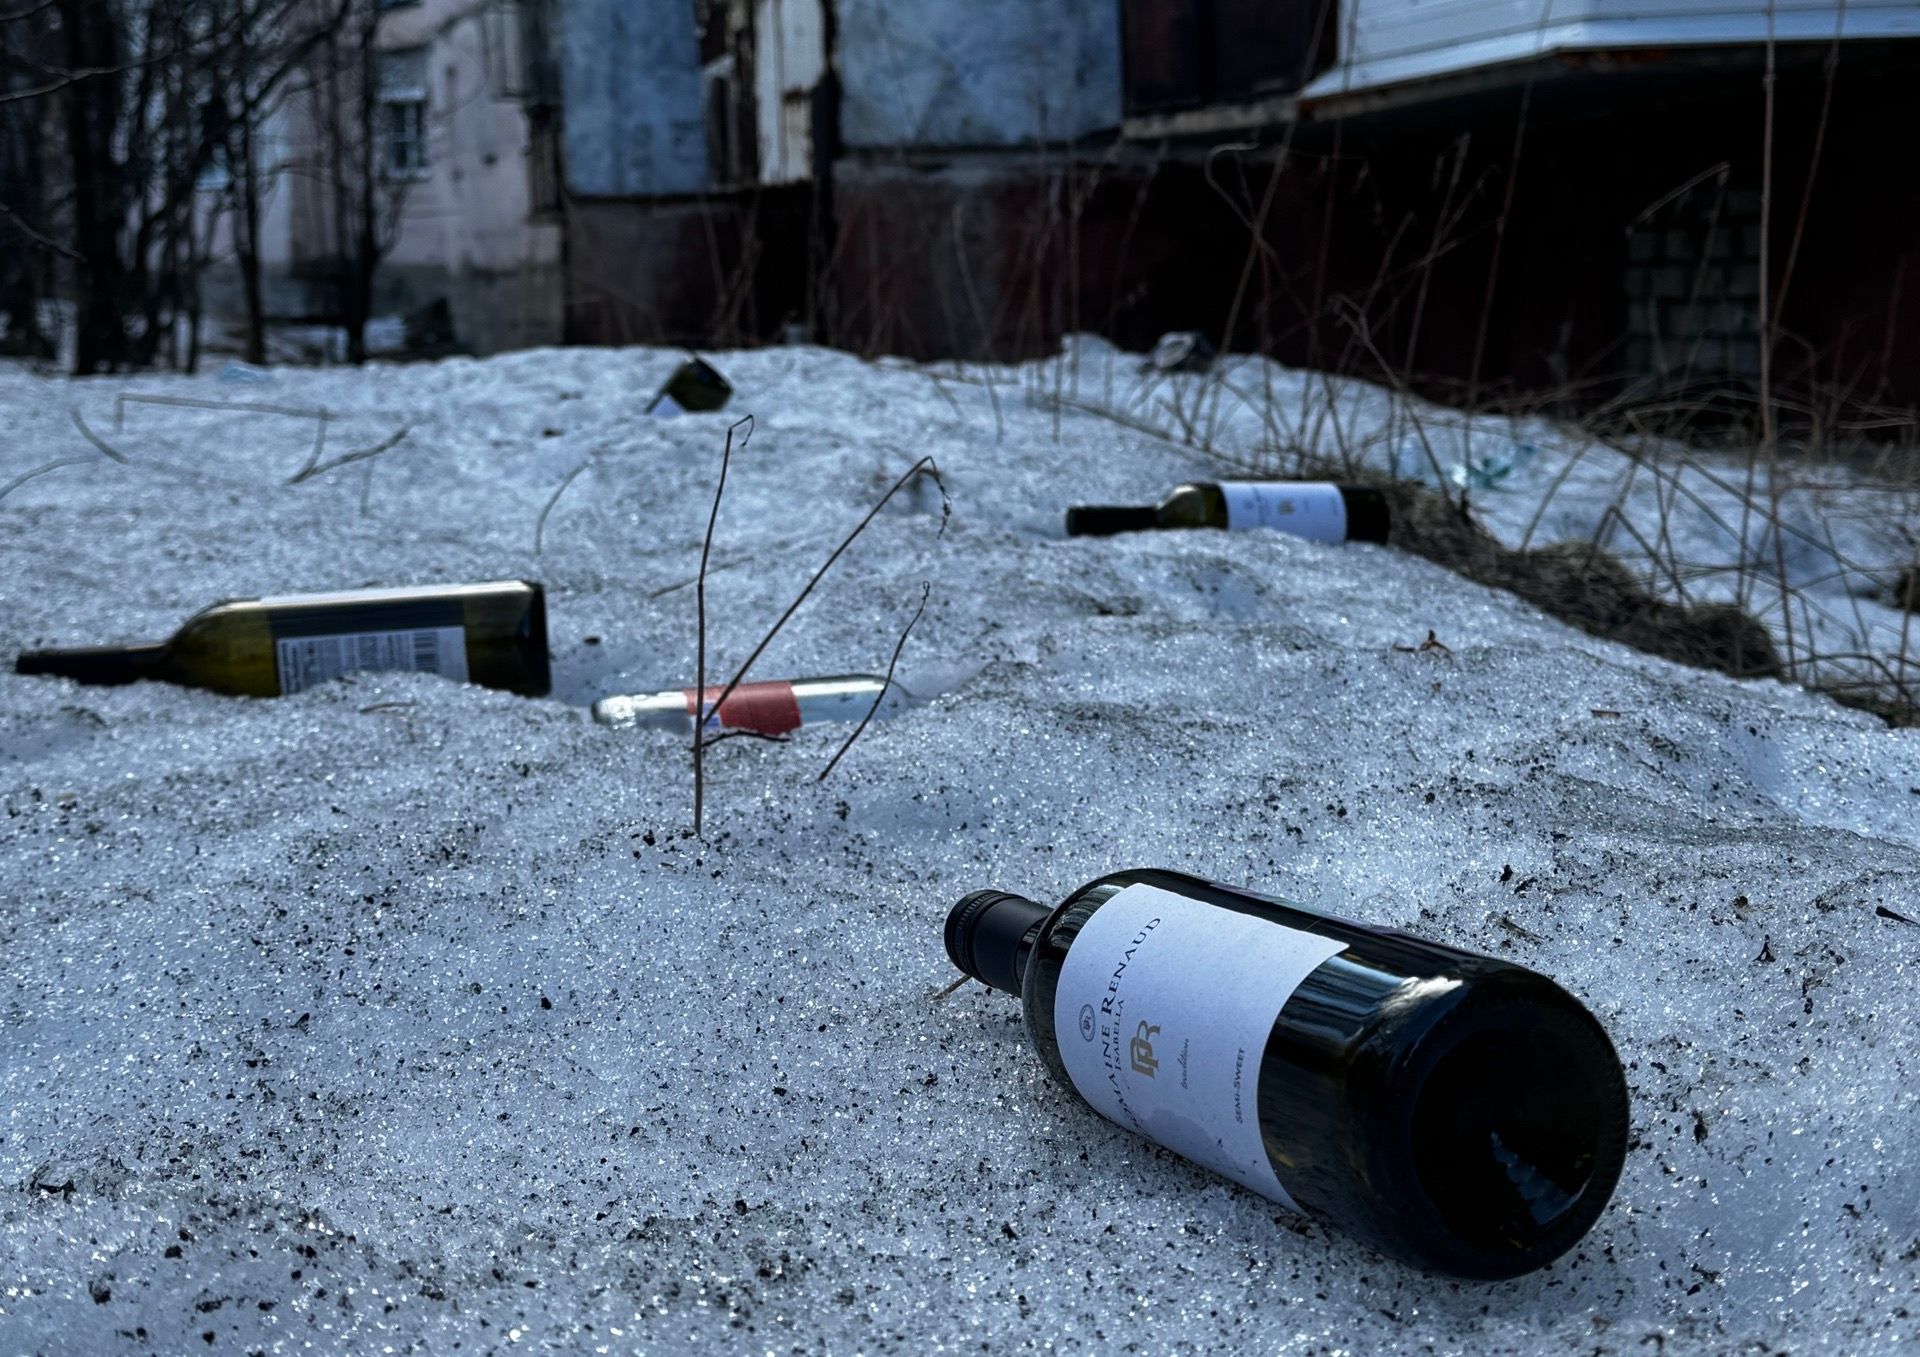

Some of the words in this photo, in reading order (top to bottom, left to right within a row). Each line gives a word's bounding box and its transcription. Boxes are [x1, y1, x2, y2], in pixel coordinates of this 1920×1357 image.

[1101, 917, 1161, 1014] RENAUD
[1113, 1000, 1124, 1071] ISABELLA
[1233, 1047, 1245, 1124] SEMI-SWEET
